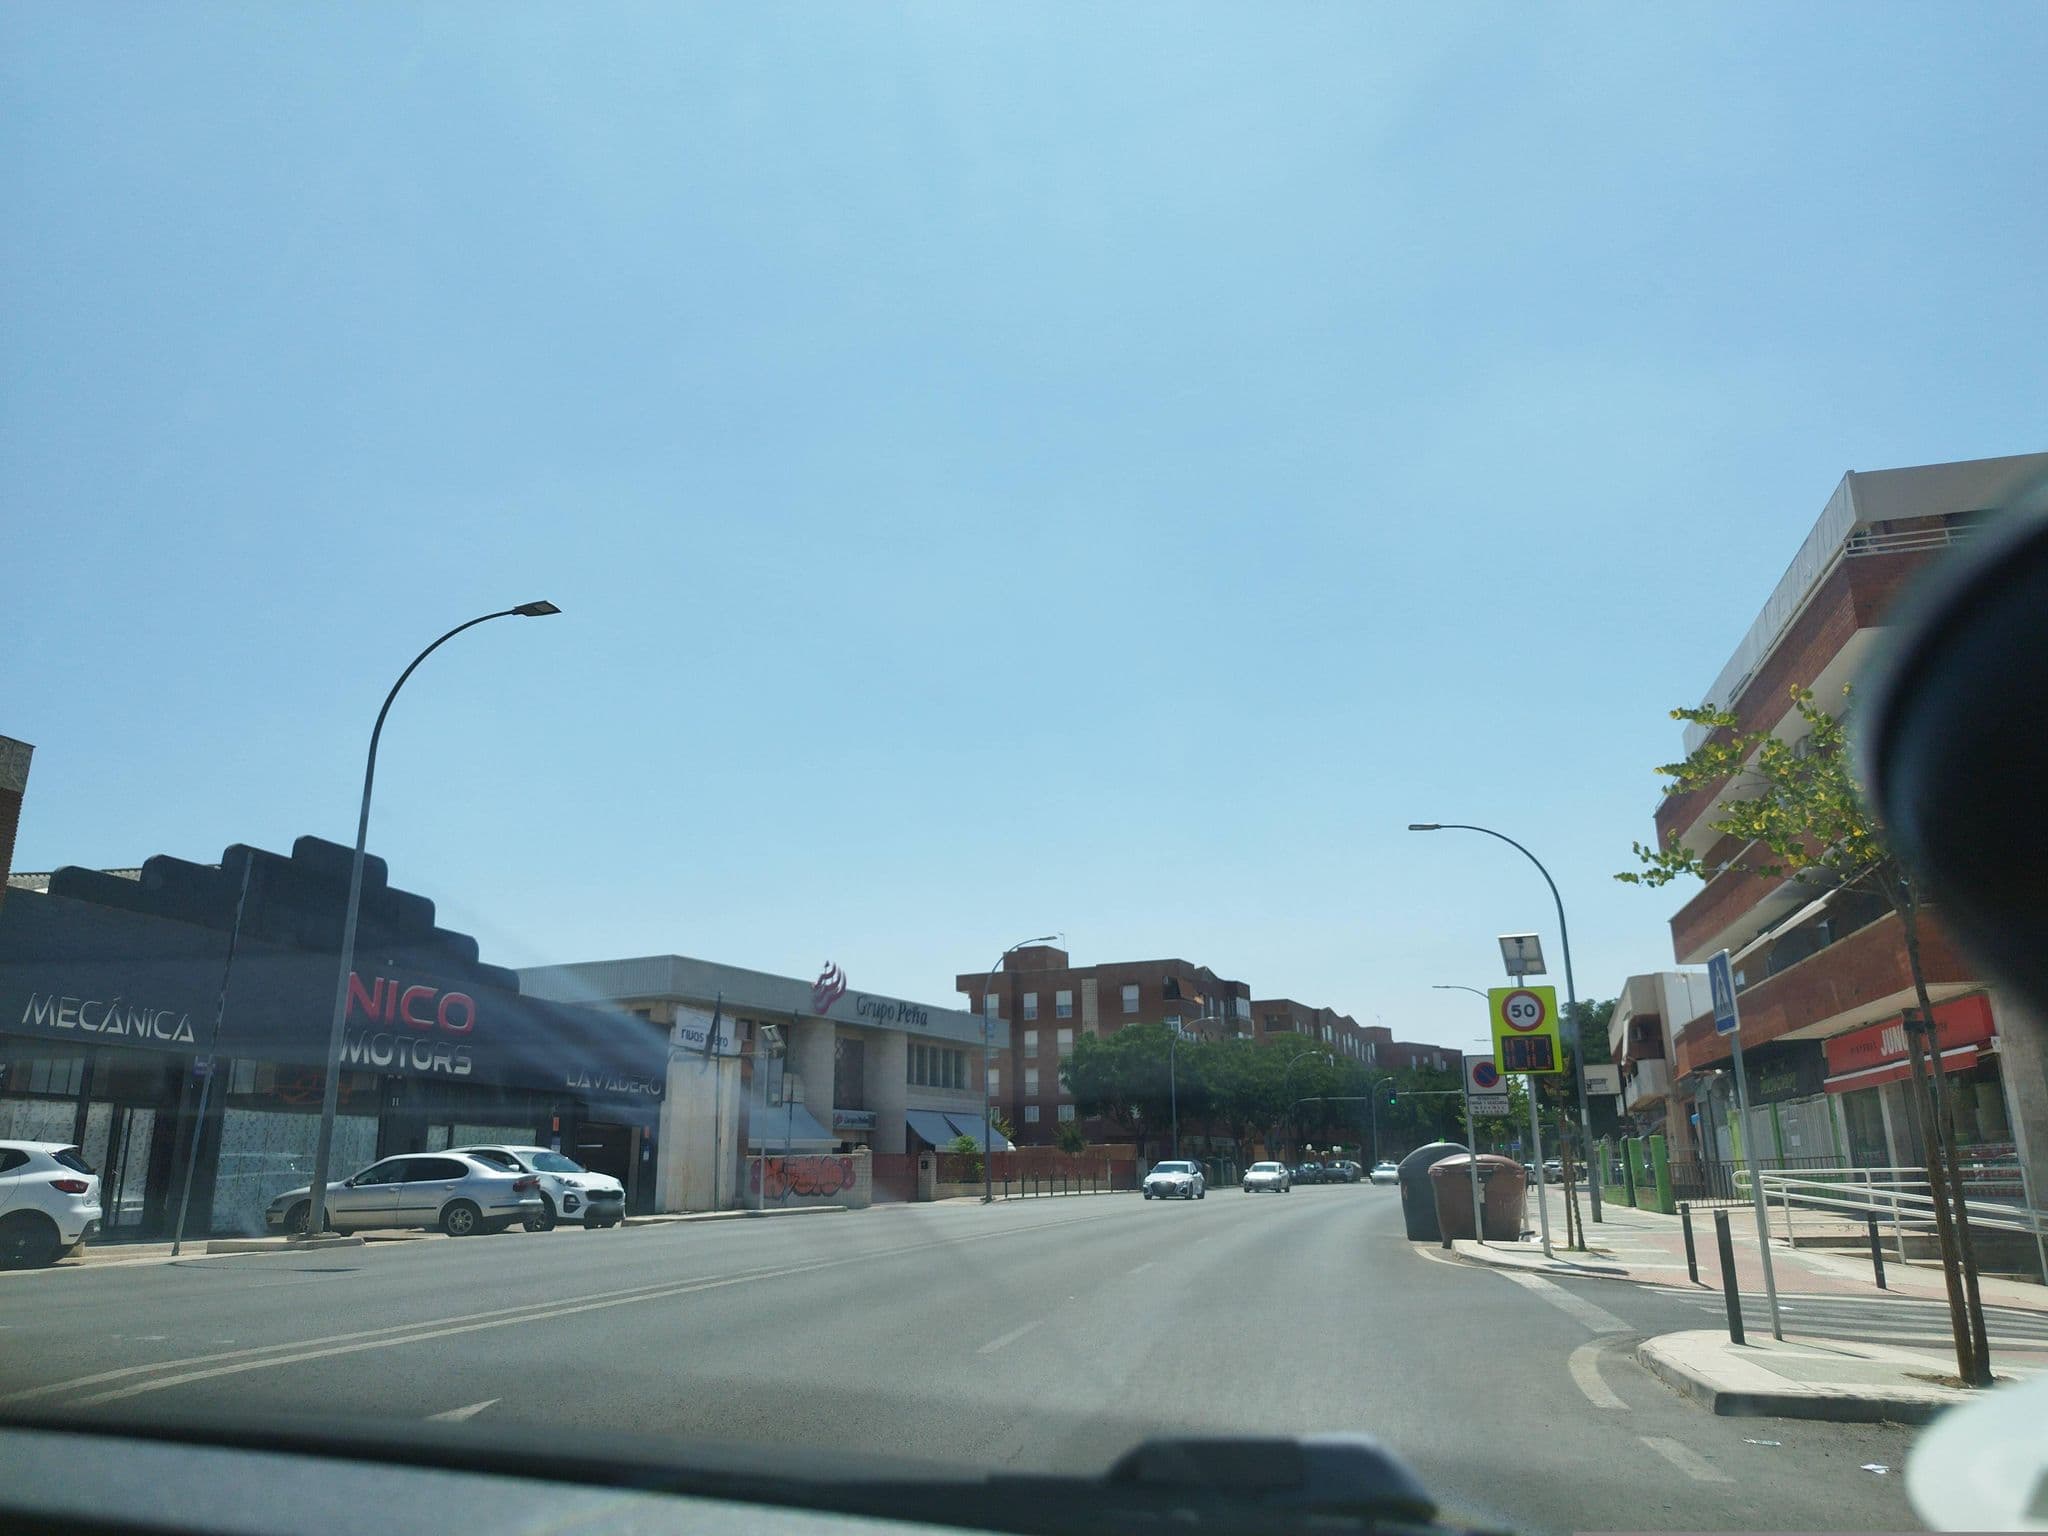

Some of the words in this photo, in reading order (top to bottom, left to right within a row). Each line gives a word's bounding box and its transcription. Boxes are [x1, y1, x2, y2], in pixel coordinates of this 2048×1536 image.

[22, 992, 195, 1043] MECÁNICA
[345, 972, 475, 1034] NICO
[856, 995, 895, 1024] Grupo
[897, 1001, 928, 1026] Peña
[1510, 1003, 1536, 1018] 50
[340, 1029, 473, 1075] MOTORS
[565, 1069, 661, 1095] LAVADERO
